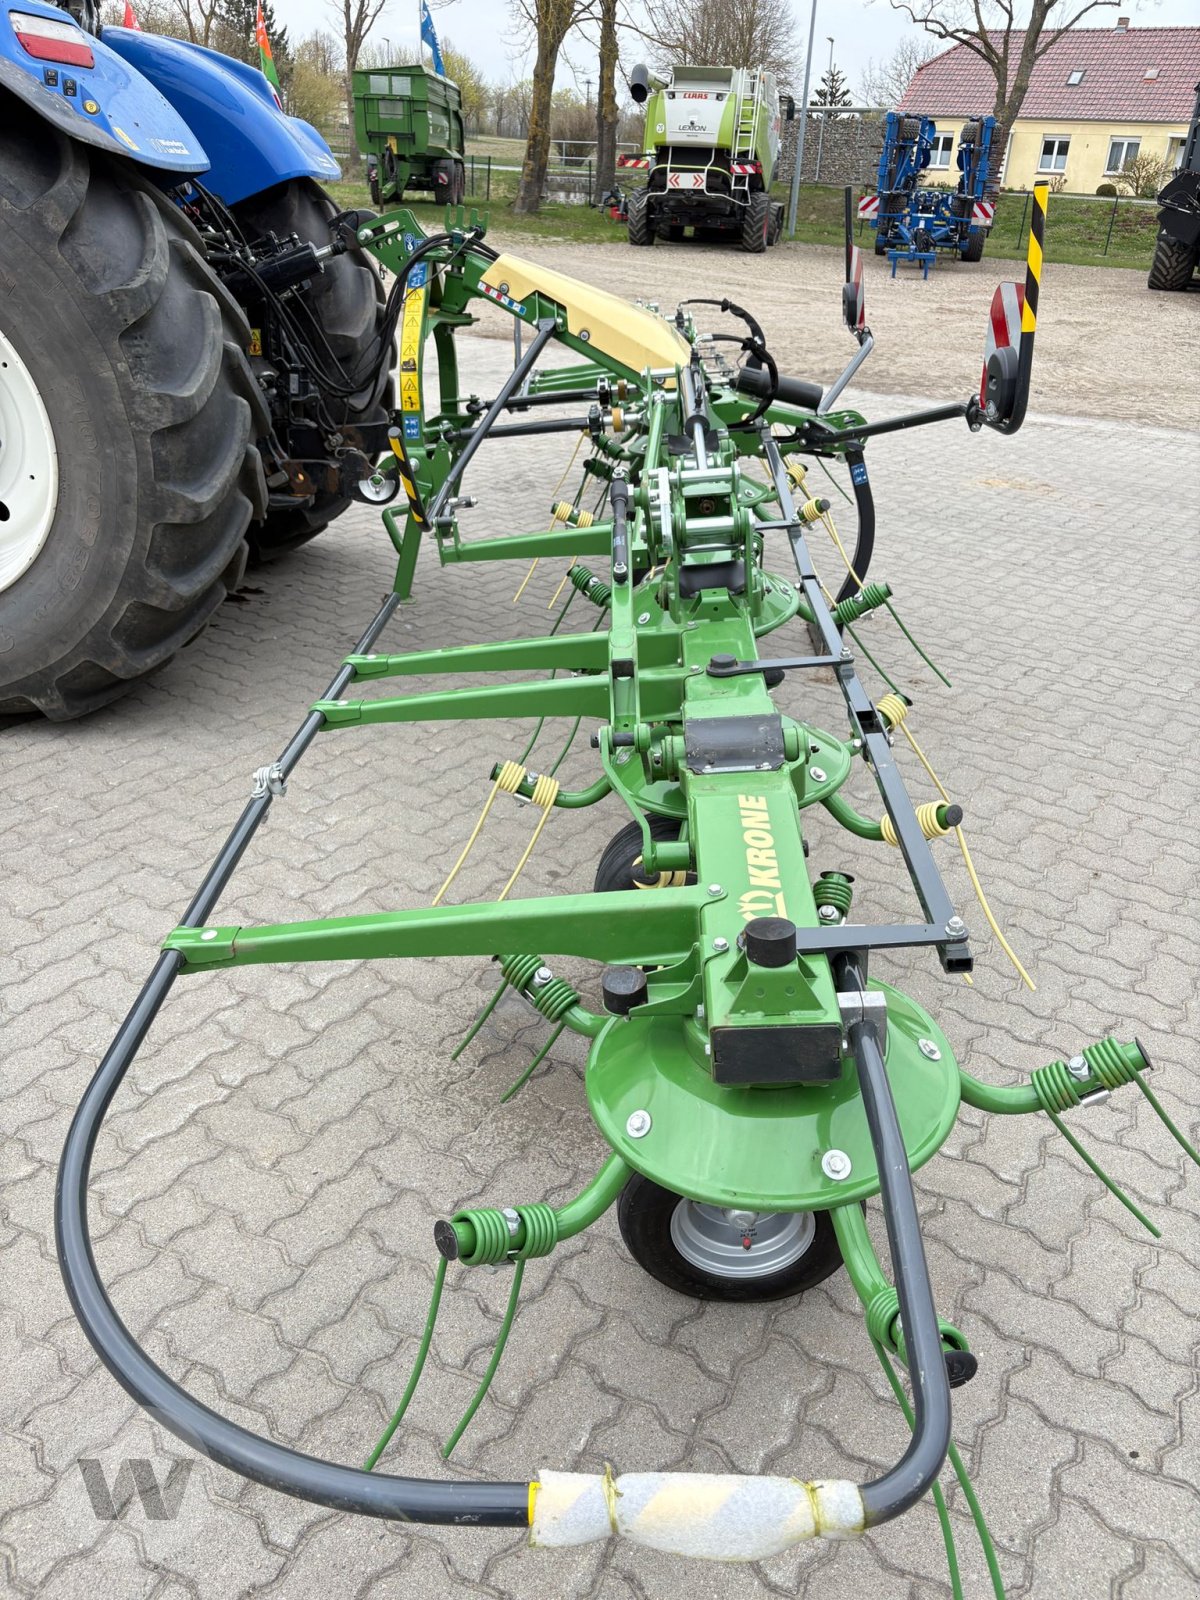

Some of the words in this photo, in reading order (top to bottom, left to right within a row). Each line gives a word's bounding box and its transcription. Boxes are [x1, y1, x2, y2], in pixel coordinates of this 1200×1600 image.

[683, 92, 708, 100] CLAAS
[678, 124, 707, 132] LEXION
[738, 794, 781, 888] KRONE
